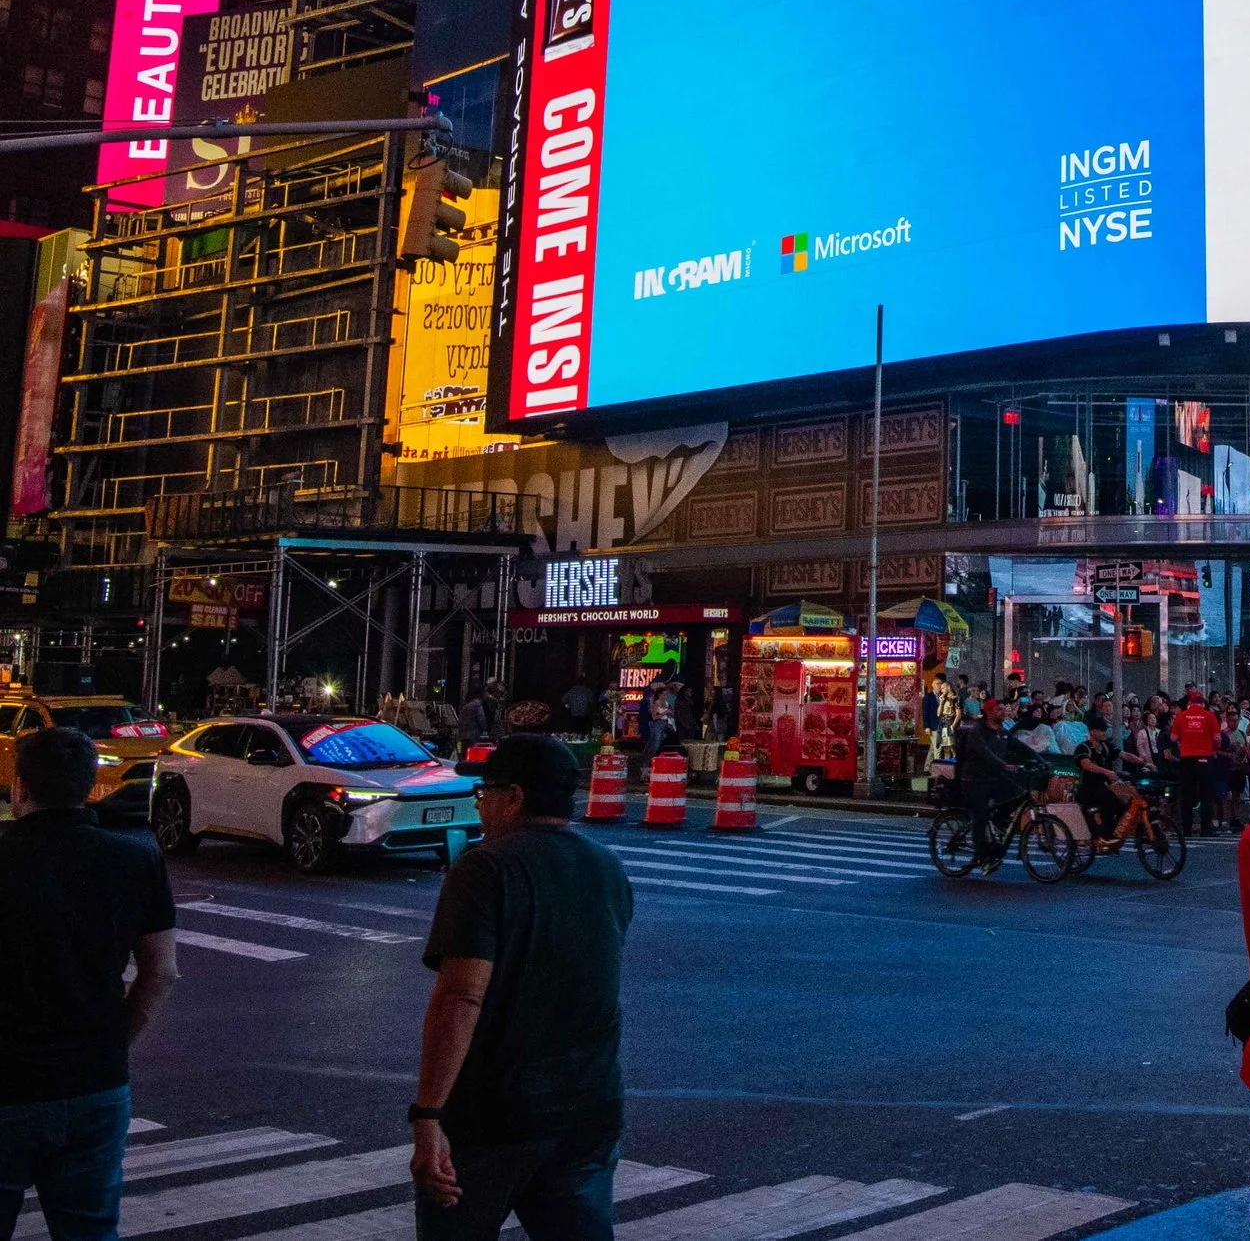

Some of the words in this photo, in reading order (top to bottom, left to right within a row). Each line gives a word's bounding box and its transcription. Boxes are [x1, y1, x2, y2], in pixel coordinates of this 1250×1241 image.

[535, 87, 596, 262] COME
[1060, 139, 1151, 184] INGM
[498, 247, 513, 338] THE
[506, 37, 527, 238] TERRACE
[1059, 179, 1152, 211] LISTED
[814, 216, 912, 262] Microsoft
[1059, 207, 1153, 251] NYSE
[525, 274, 585, 418] INSI
[544, 558, 619, 608] HERSHE
[1102, 567, 1118, 579] ONE
[1120, 565, 1137, 577] WAY
[538, 611, 578, 624] HERSHEY'S
[581, 609, 629, 622] CHOCOLATE
[630, 608, 659, 620] WORLD
[703, 608, 729, 618] HERSHEY'S
[1100, 590, 1116, 600] ONE
[1119, 589, 1136, 600] WAY
[861, 639, 913, 655] CICKEN
